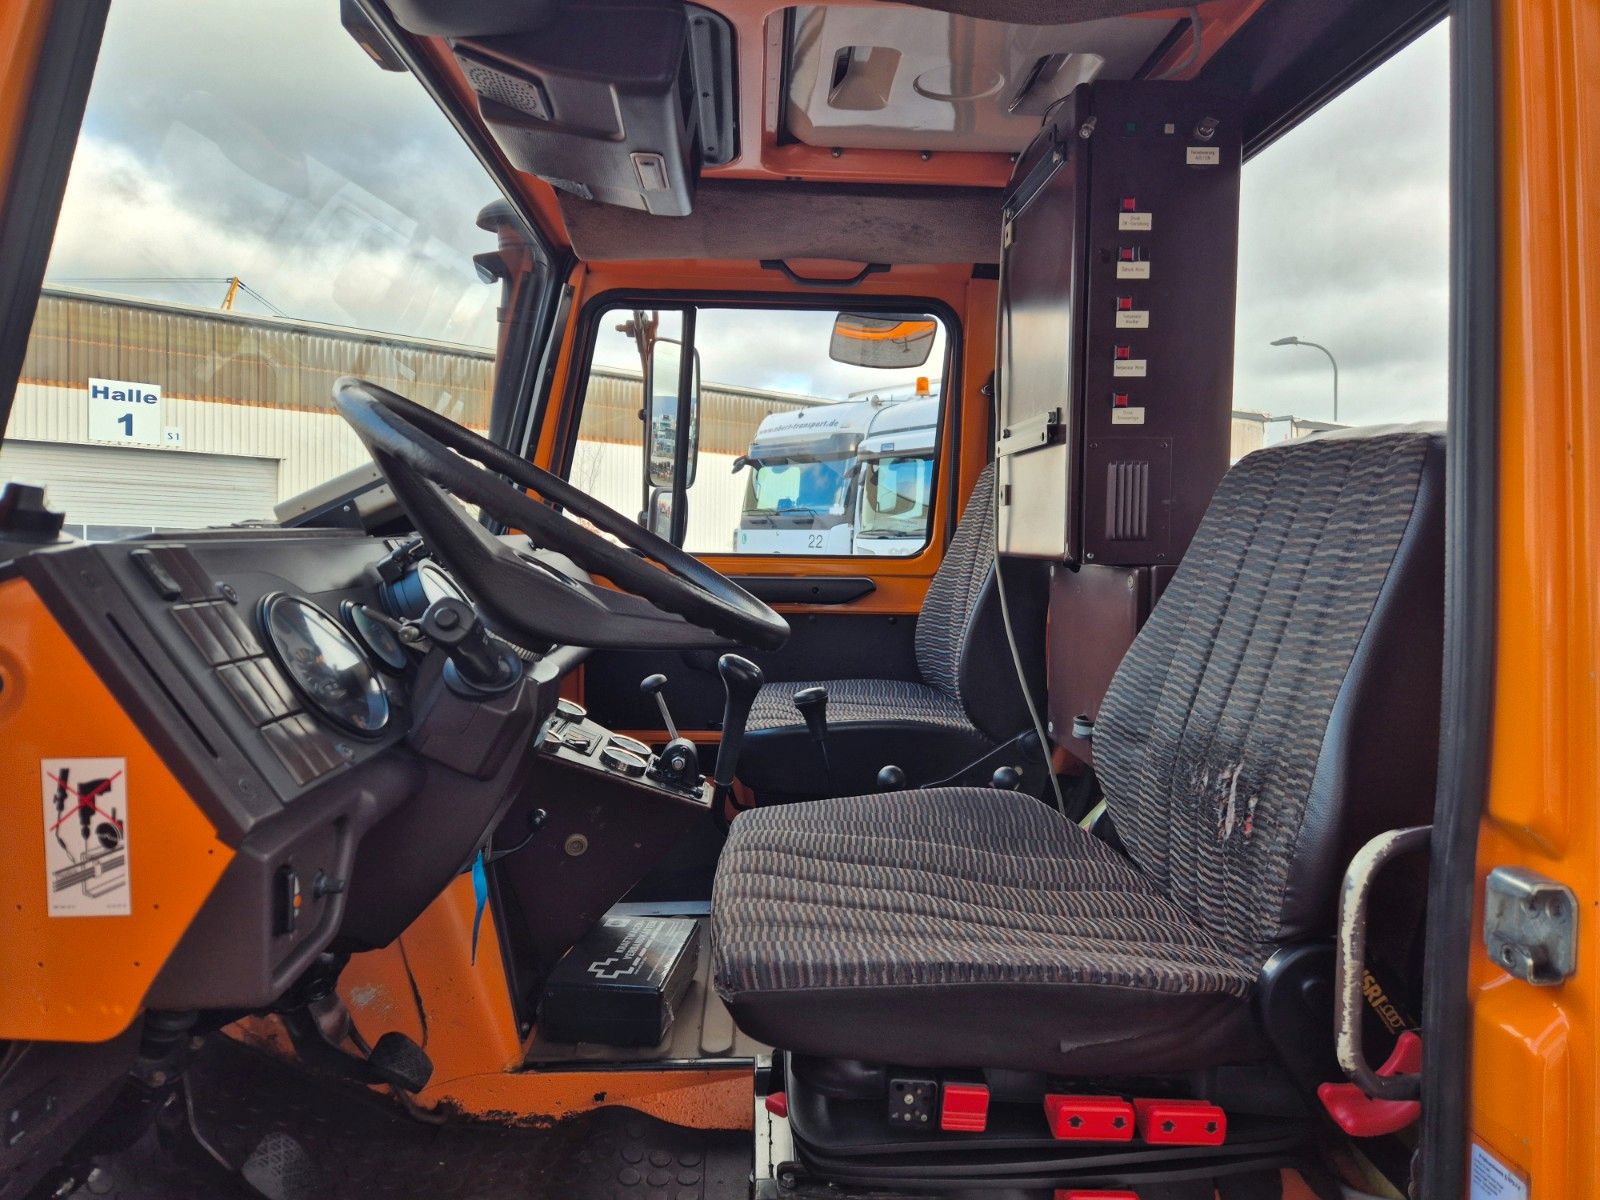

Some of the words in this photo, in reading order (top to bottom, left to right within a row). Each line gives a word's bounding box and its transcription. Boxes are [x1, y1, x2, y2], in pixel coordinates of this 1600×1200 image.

[92, 385, 158, 405] Halle
[117, 413, 133, 436] 1
[808, 534, 824, 549] 22
